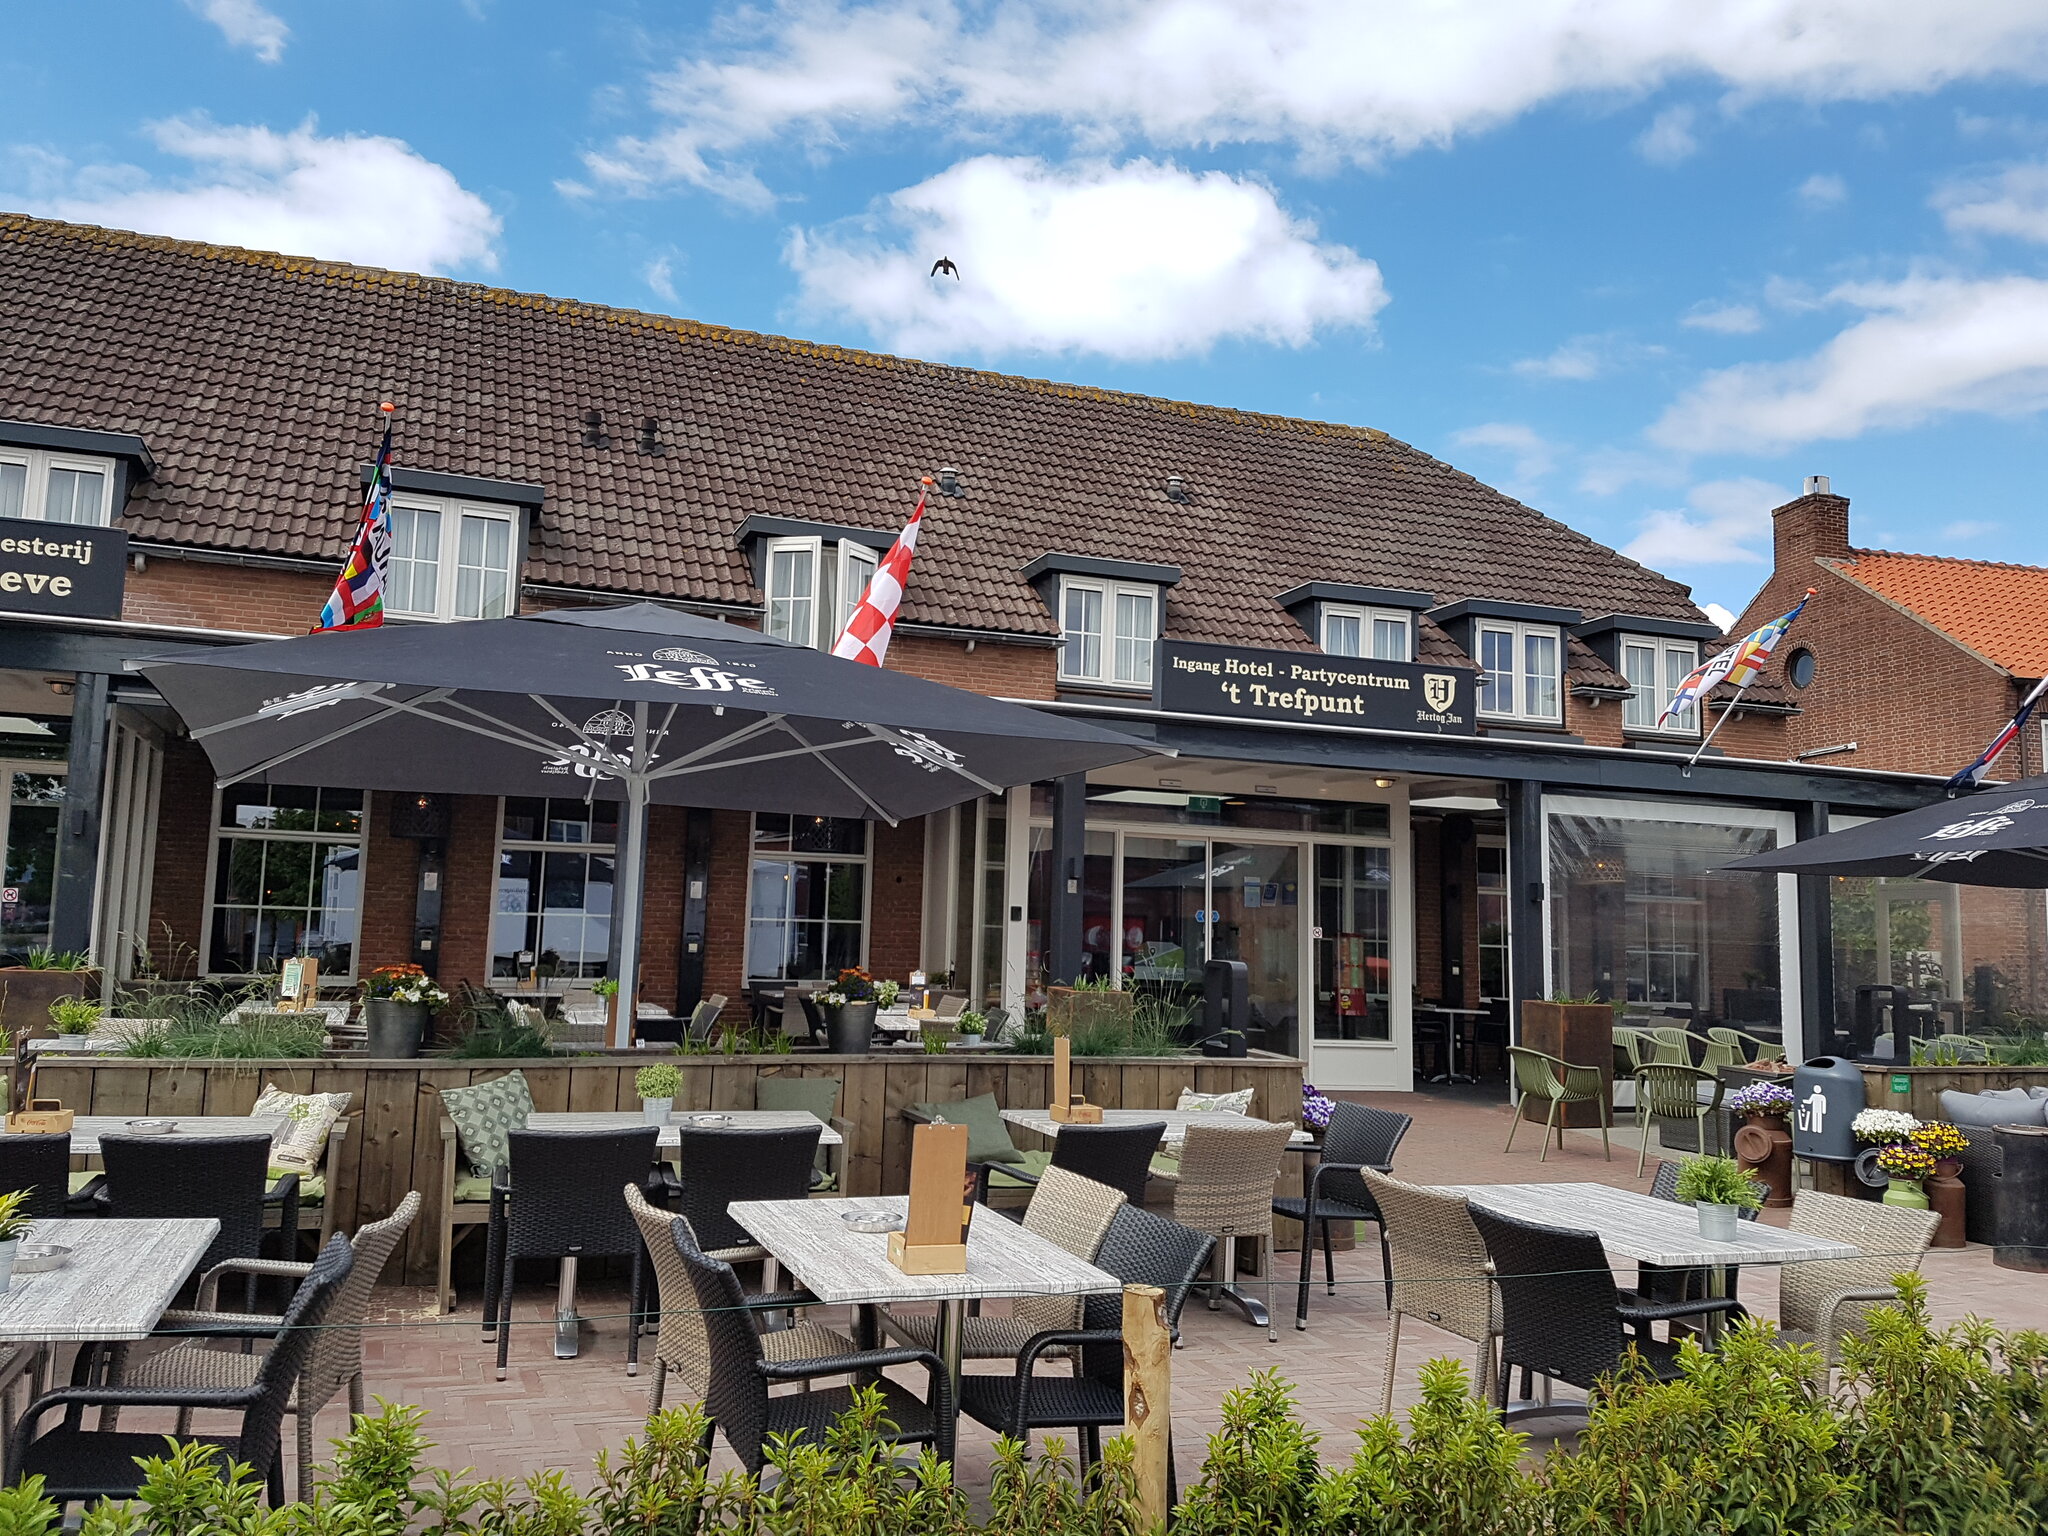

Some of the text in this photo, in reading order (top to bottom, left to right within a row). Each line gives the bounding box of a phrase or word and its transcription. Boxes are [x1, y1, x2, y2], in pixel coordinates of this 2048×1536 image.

[0, 537, 92, 565] esterij
[0, 571, 72, 597] eve
[1172, 656, 1221, 675] Ingang
[1224, 658, 1274, 678] Hotel
[1290, 664, 1411, 690] Partycentrum
[1707, 641, 1741, 677] OTEL
[613, 663, 768, 692] Leffe
[1249, 683, 1365, 717] Trefpunt
[1416, 709, 1463, 726] Hertog Jan
